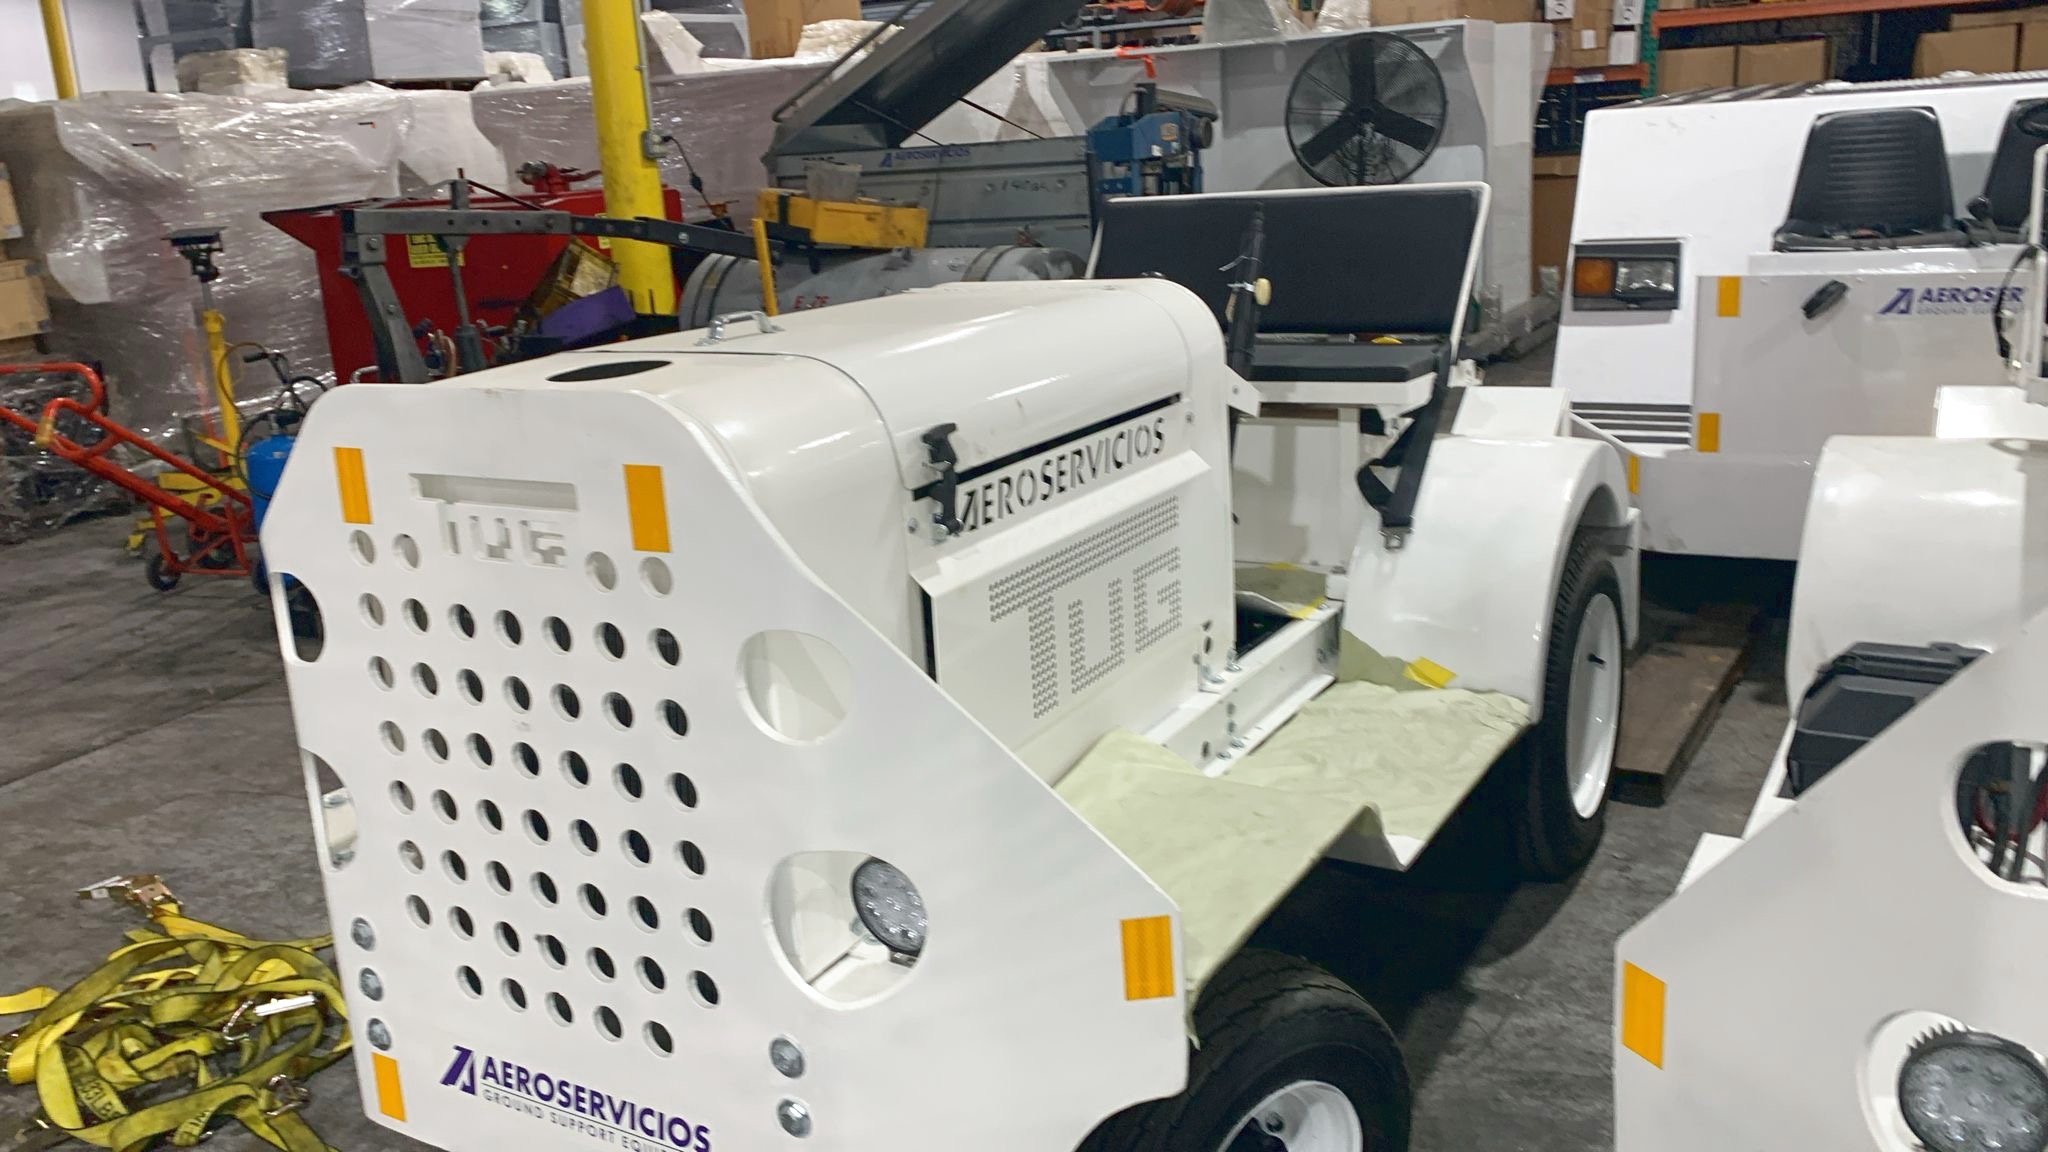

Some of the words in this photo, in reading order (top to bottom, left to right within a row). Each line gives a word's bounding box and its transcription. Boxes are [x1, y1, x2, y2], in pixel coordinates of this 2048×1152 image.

[960, 417, 1166, 531] AEROSERVICIOS
[988, 497, 1183, 719] TUG
[481, 1055, 712, 1152] AEROSERVICIOS
[482, 1088, 545, 1120] GROUND
[549, 1111, 616, 1143] SUPPORT
